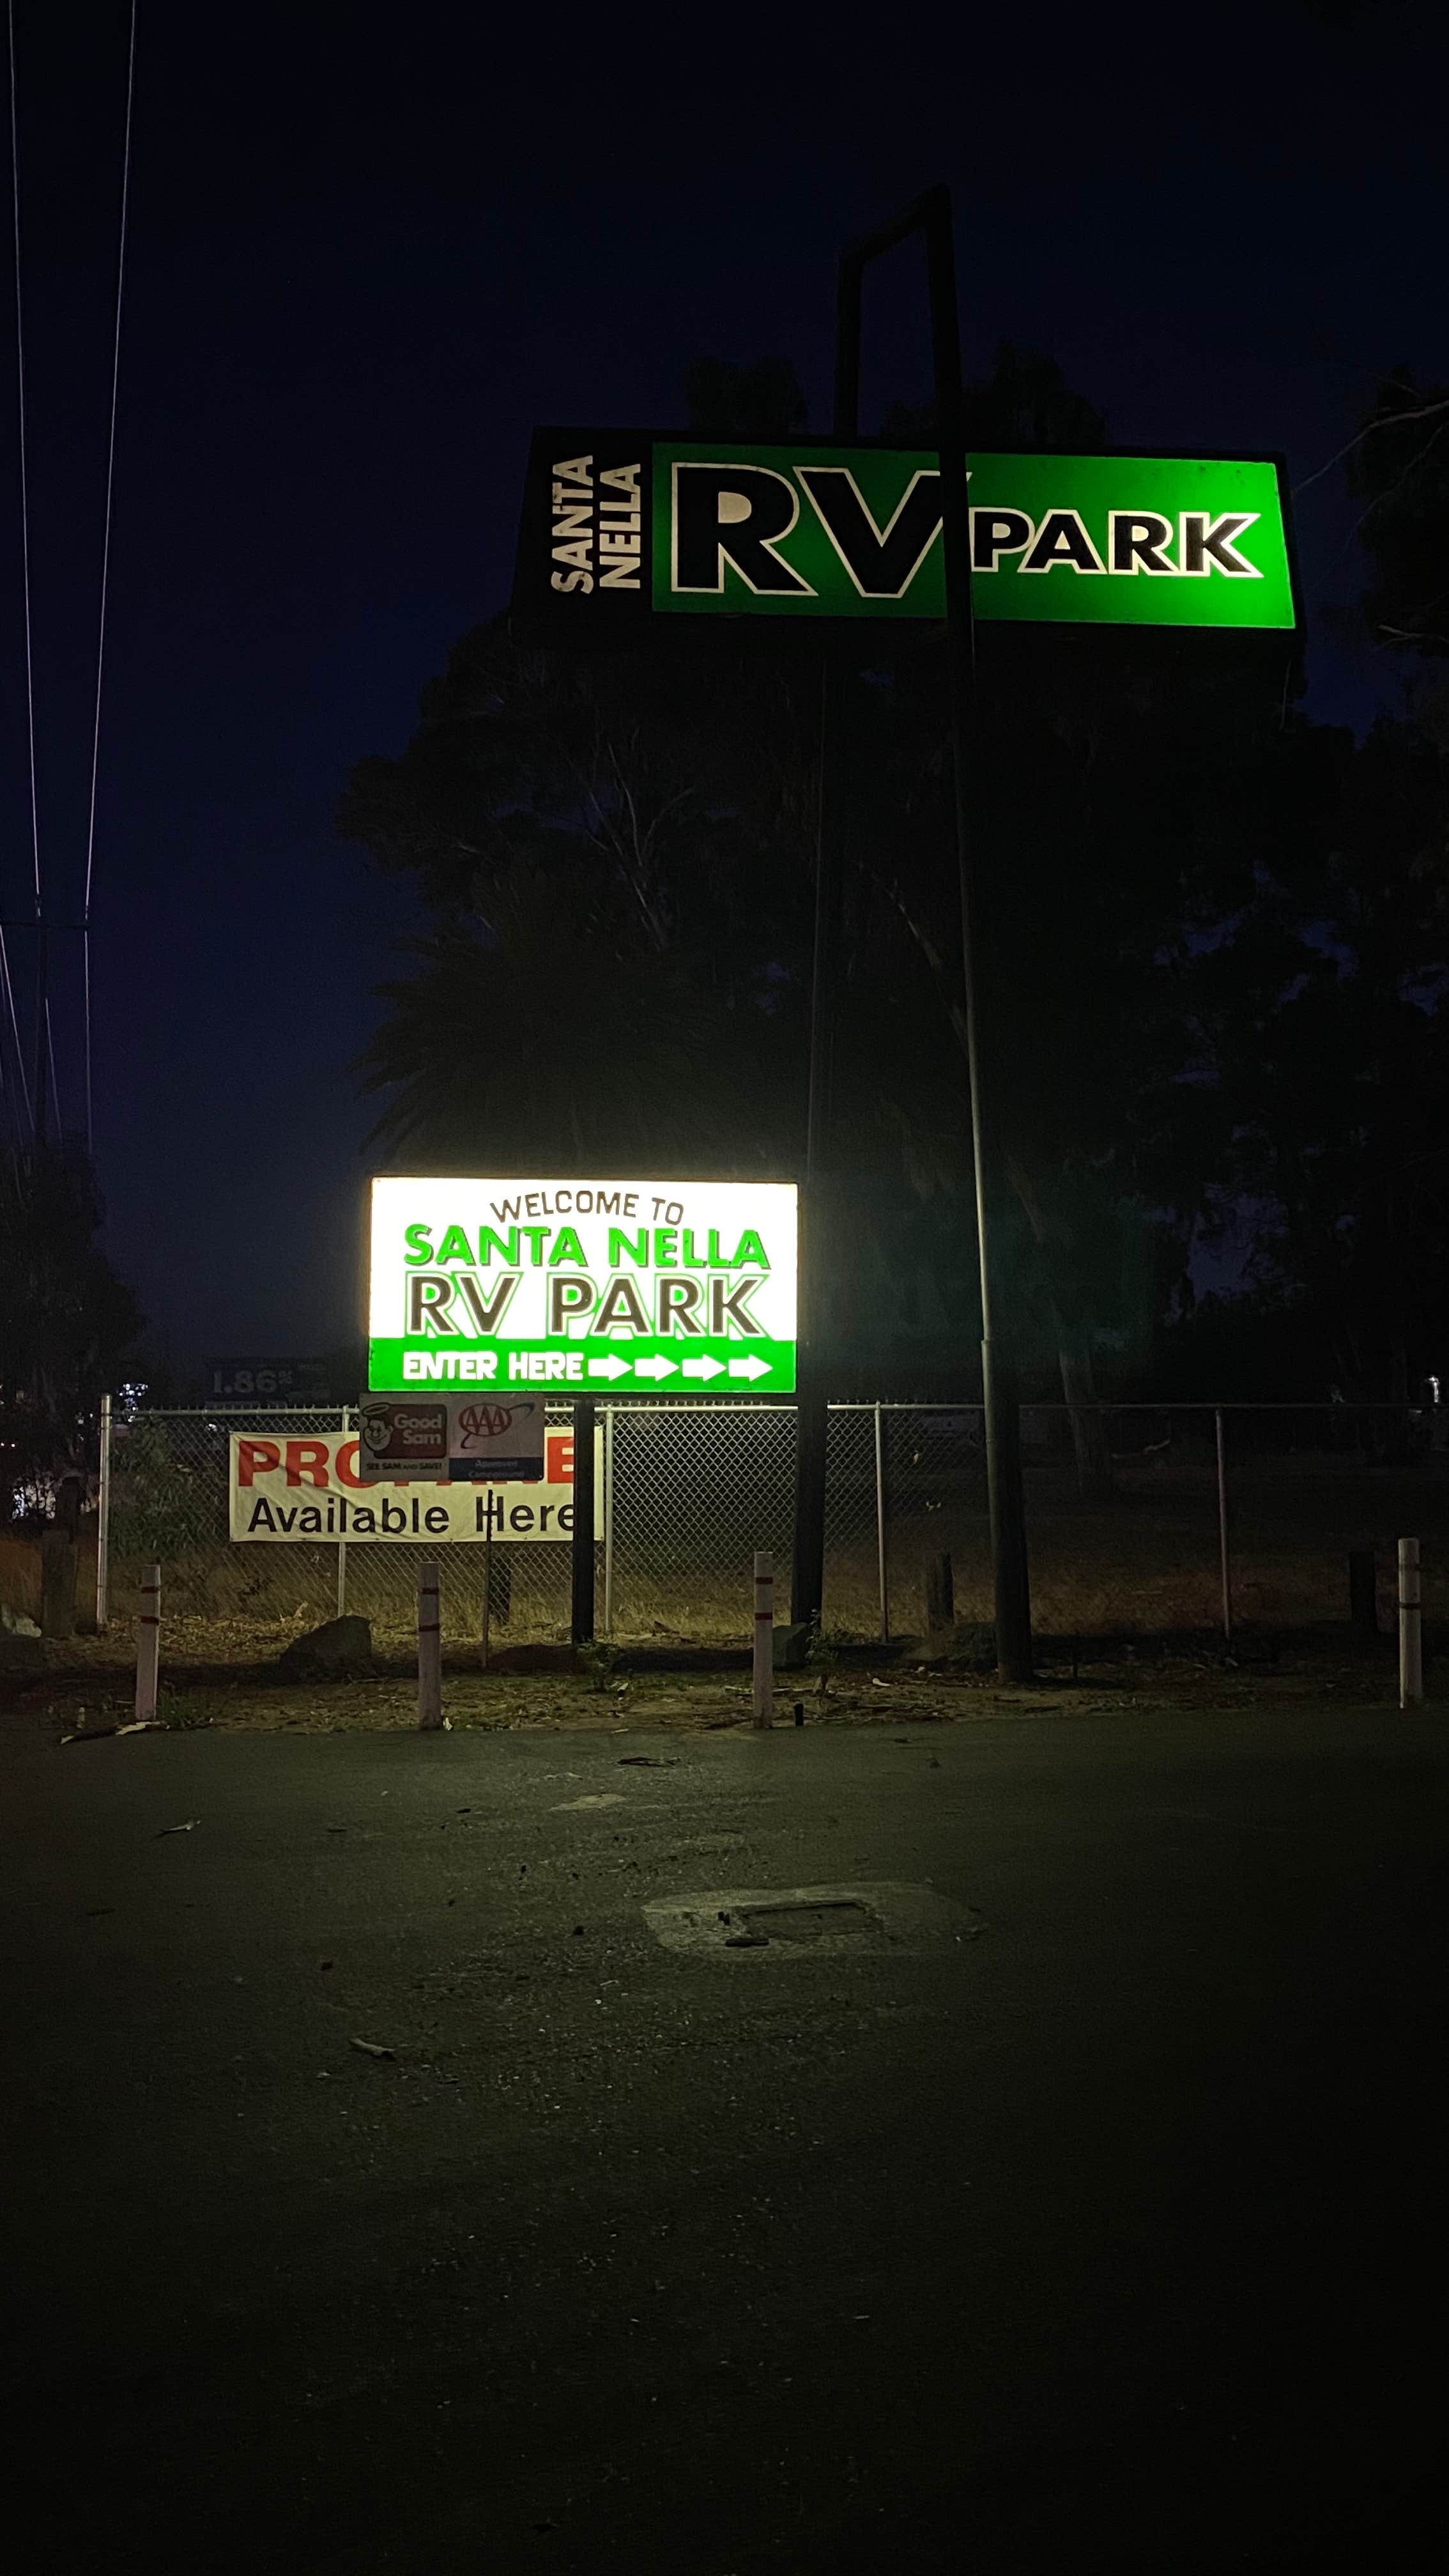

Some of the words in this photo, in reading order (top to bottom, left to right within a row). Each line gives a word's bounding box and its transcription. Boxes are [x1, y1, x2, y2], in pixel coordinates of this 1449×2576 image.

[551, 455, 594, 594] SANTA
[599, 463, 641, 589] NELLA
[670, 461, 972, 599] RV
[968, 507, 1264, 579] PARK
[490, 1190, 640, 1223] WELCOME
[651, 1197, 684, 1226] TO
[404, 1223, 588, 1268] SANTA
[609, 1227, 772, 1270] NELLA
[406, 1271, 523, 1338] RV
[546, 1272, 770, 1339] PARK
[402, 1350, 498, 1381] ENTER
[509, 1351, 585, 1382] HERE
[394, 1413, 442, 1429] Good
[402, 1429, 442, 1445] Sam
[464, 1404, 510, 1436] AAA
[238, 1436, 574, 1488] PROE
[381, 1462, 401, 1470] SAM
[247, 1498, 449, 1533] Available
[475, 1496, 574, 1532] Here
